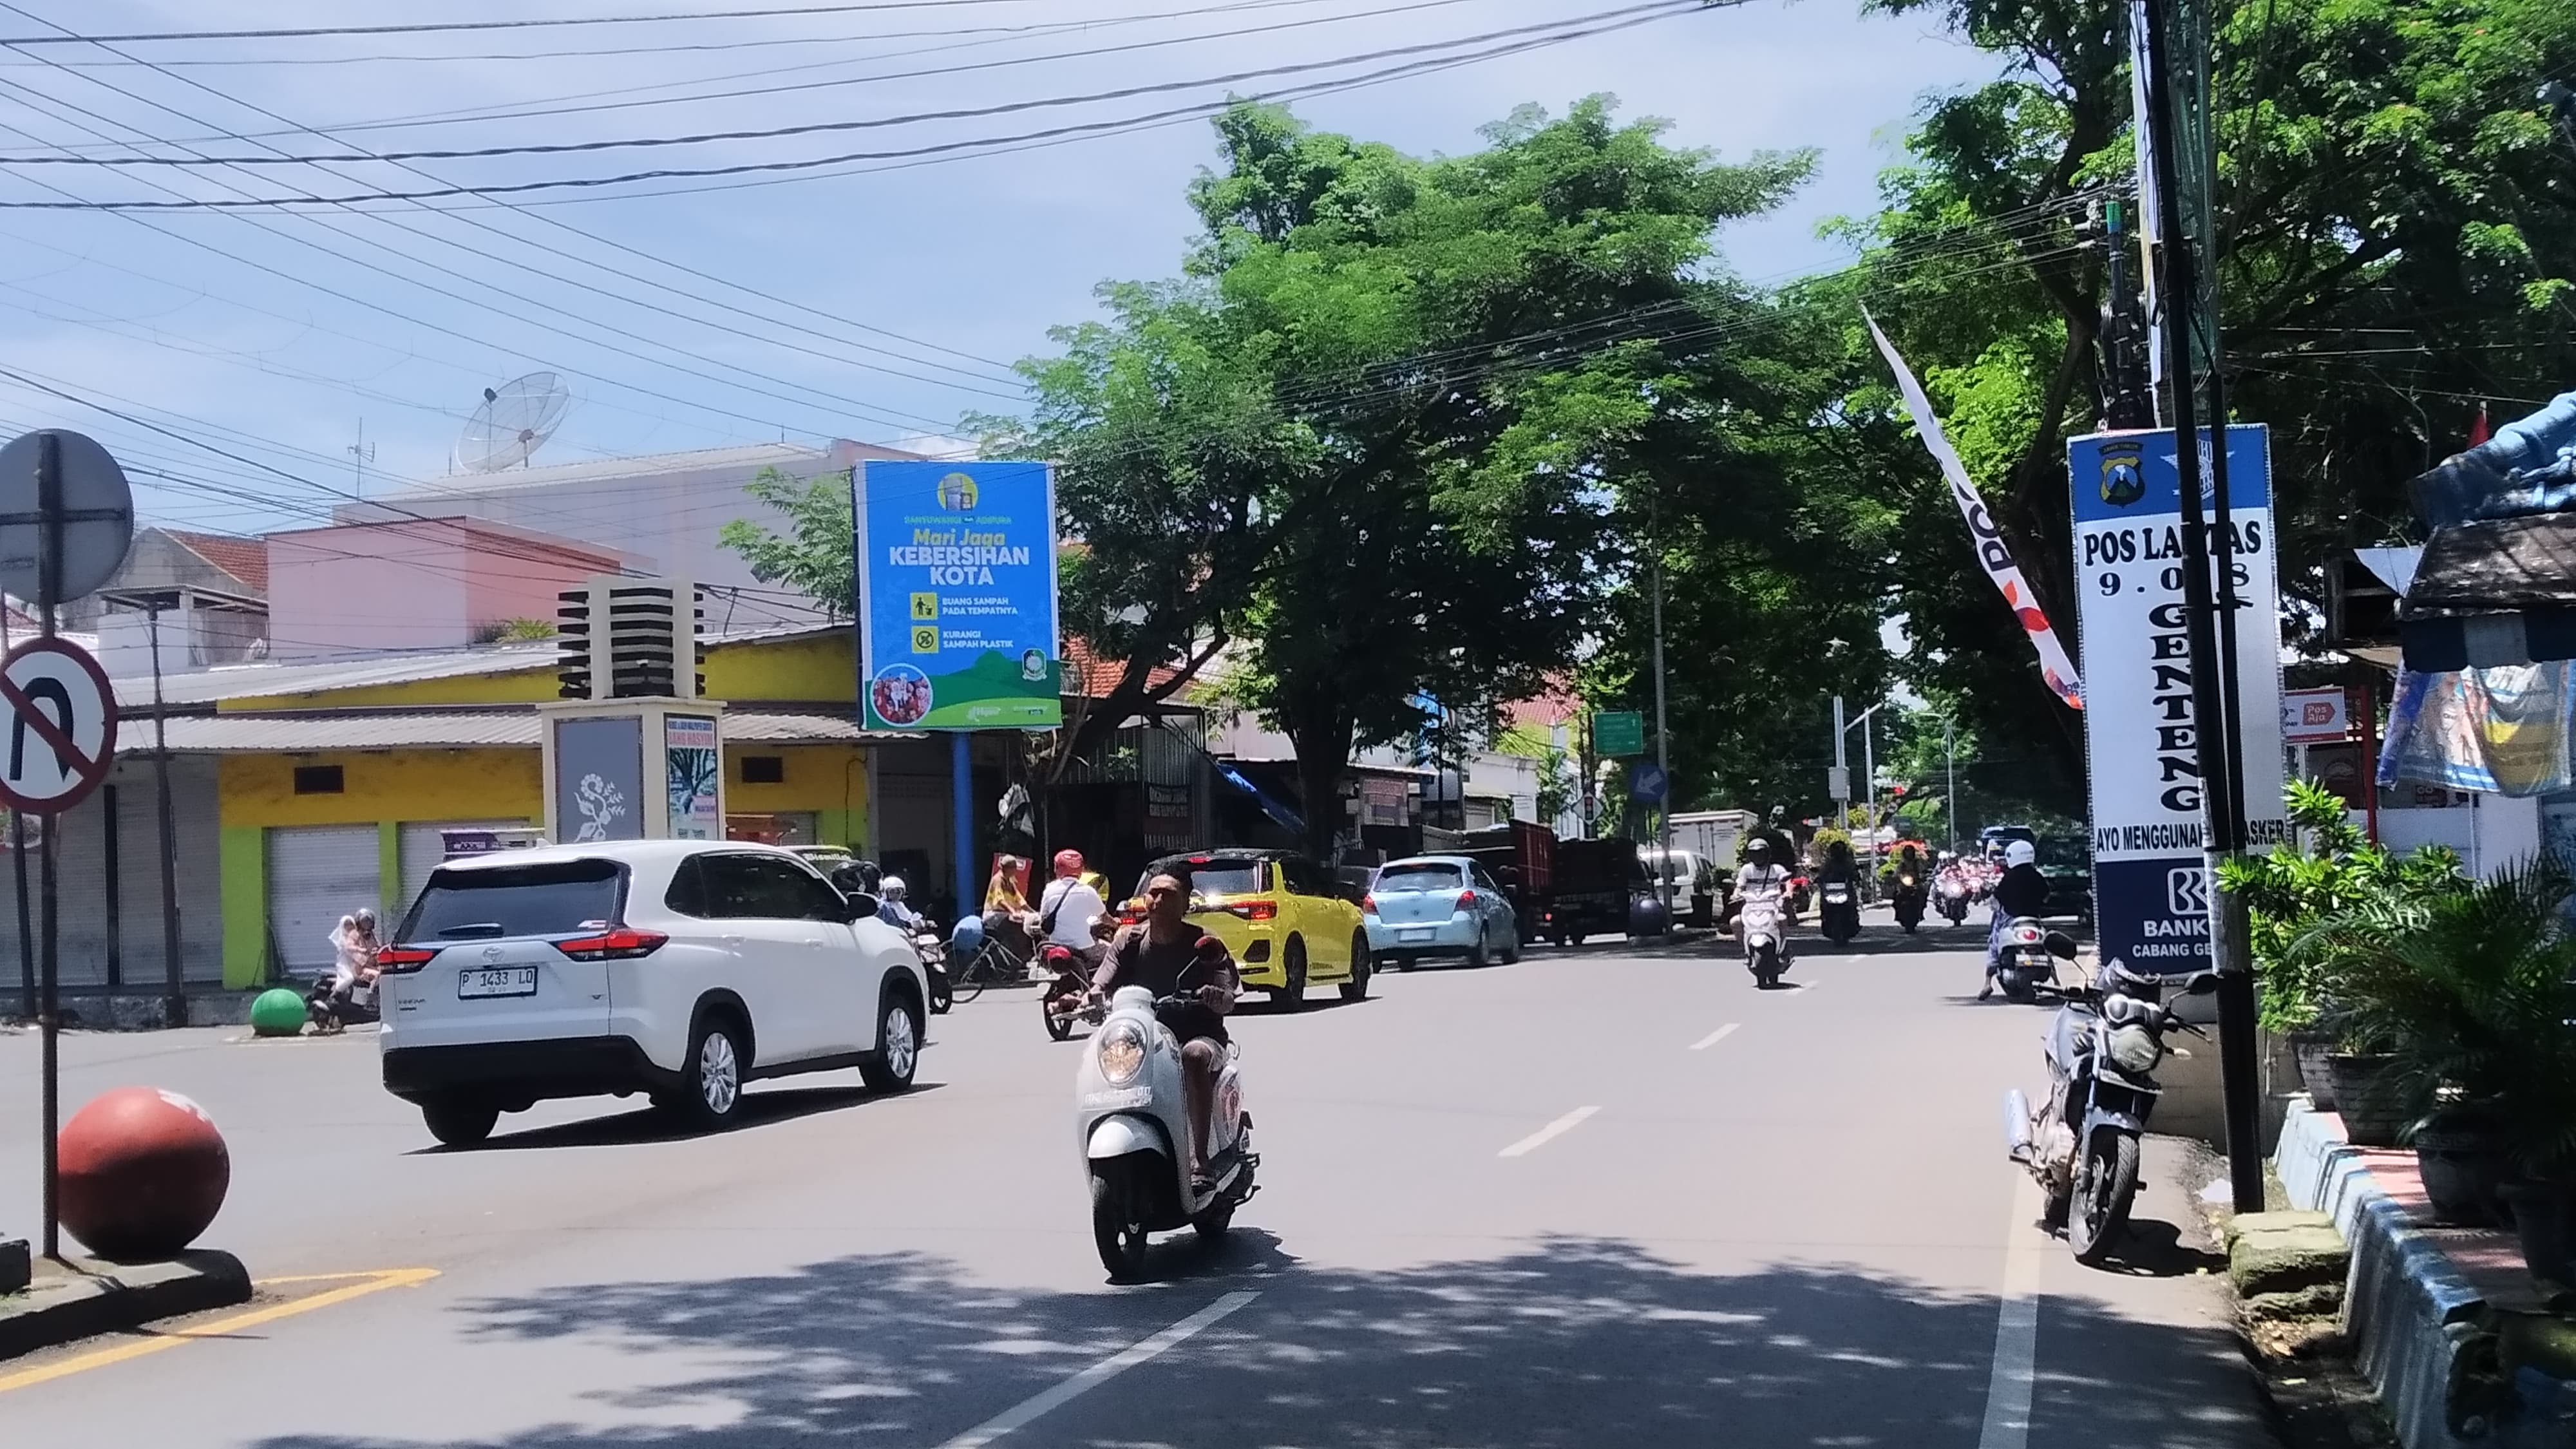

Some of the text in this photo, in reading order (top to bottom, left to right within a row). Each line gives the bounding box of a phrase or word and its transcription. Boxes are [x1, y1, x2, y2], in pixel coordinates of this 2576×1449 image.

[913, 528, 1005, 548] Mari Jaga
[889, 546, 1030, 565] KEBERSIHAN
[2083, 529, 2136, 566] POS
[929, 566, 994, 585] KOTA
[942, 597, 1009, 605] BUANG SAMPAH
[942, 607, 1018, 615] PADA TEMPATNYA
[943, 630, 981, 639] KURANGI
[943, 639, 1014, 649] SAMPAH PLASTIK
[2096, 827, 2119, 852] AYO
[2143, 918, 2209, 937] BANK
[2132, 942, 2212, 958] CABANG GE
[462, 974, 470, 987] P
[480, 972, 508, 987] 1433
